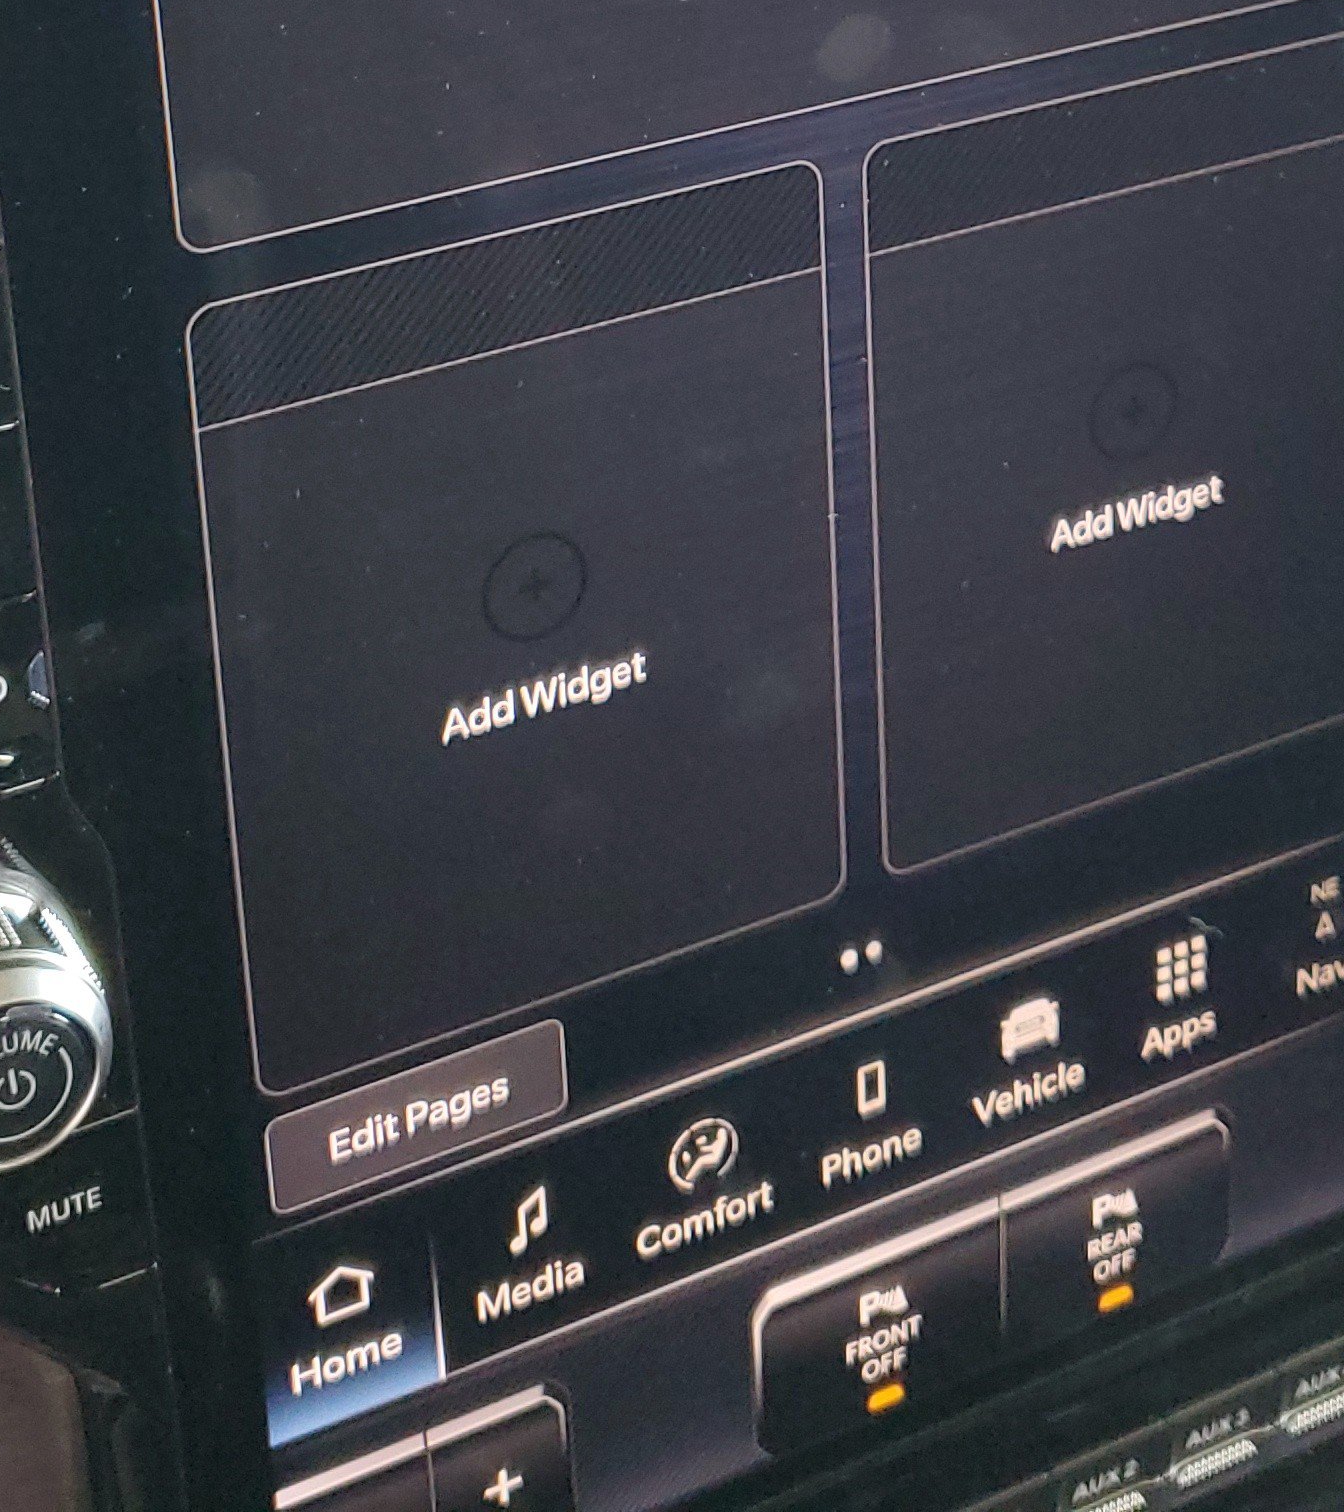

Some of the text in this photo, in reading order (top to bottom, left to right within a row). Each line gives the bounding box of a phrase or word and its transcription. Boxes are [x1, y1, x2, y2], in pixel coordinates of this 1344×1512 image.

[1051, 476, 1226, 554] Add Widget
[442, 652, 647, 747] Add Widget
[1140, 1010, 1218, 1063] Apps
[329, 1076, 510, 1165] Edit Pages
[971, 1061, 1086, 1128] Vehicle
[821, 1126, 923, 1189] Phone
[26, 1186, 103, 1234] MUTE
[636, 1180, 774, 1260] Comfort
[1087, 1221, 1143, 1263] REAR
[476, 1259, 586, 1324] Media
[1092, 1248, 1137, 1285] OFF
[291, 1332, 404, 1397] Home
[846, 1314, 923, 1368] FRONT
[861, 1345, 906, 1384] OFF
